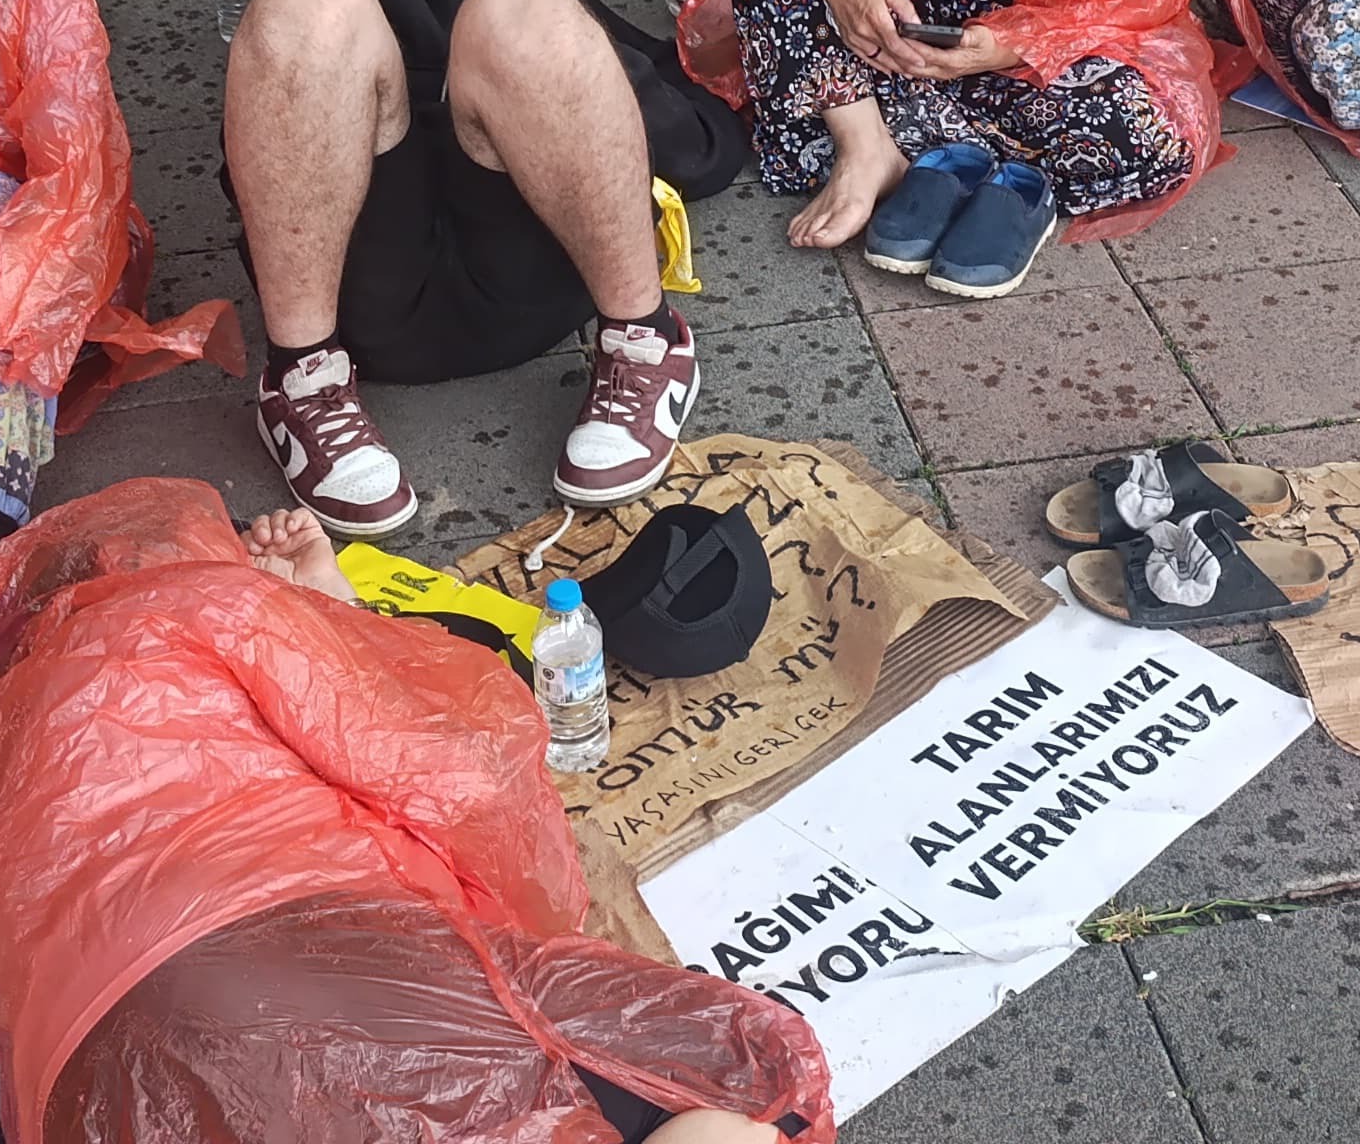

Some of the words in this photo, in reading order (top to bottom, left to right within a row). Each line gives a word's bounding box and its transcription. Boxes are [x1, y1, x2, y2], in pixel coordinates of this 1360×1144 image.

[908, 657, 1180, 868] ALANLARIMIZI
[910, 671, 1064, 774] TARIM
[947, 683, 1239, 900] VERMİYORUZ
